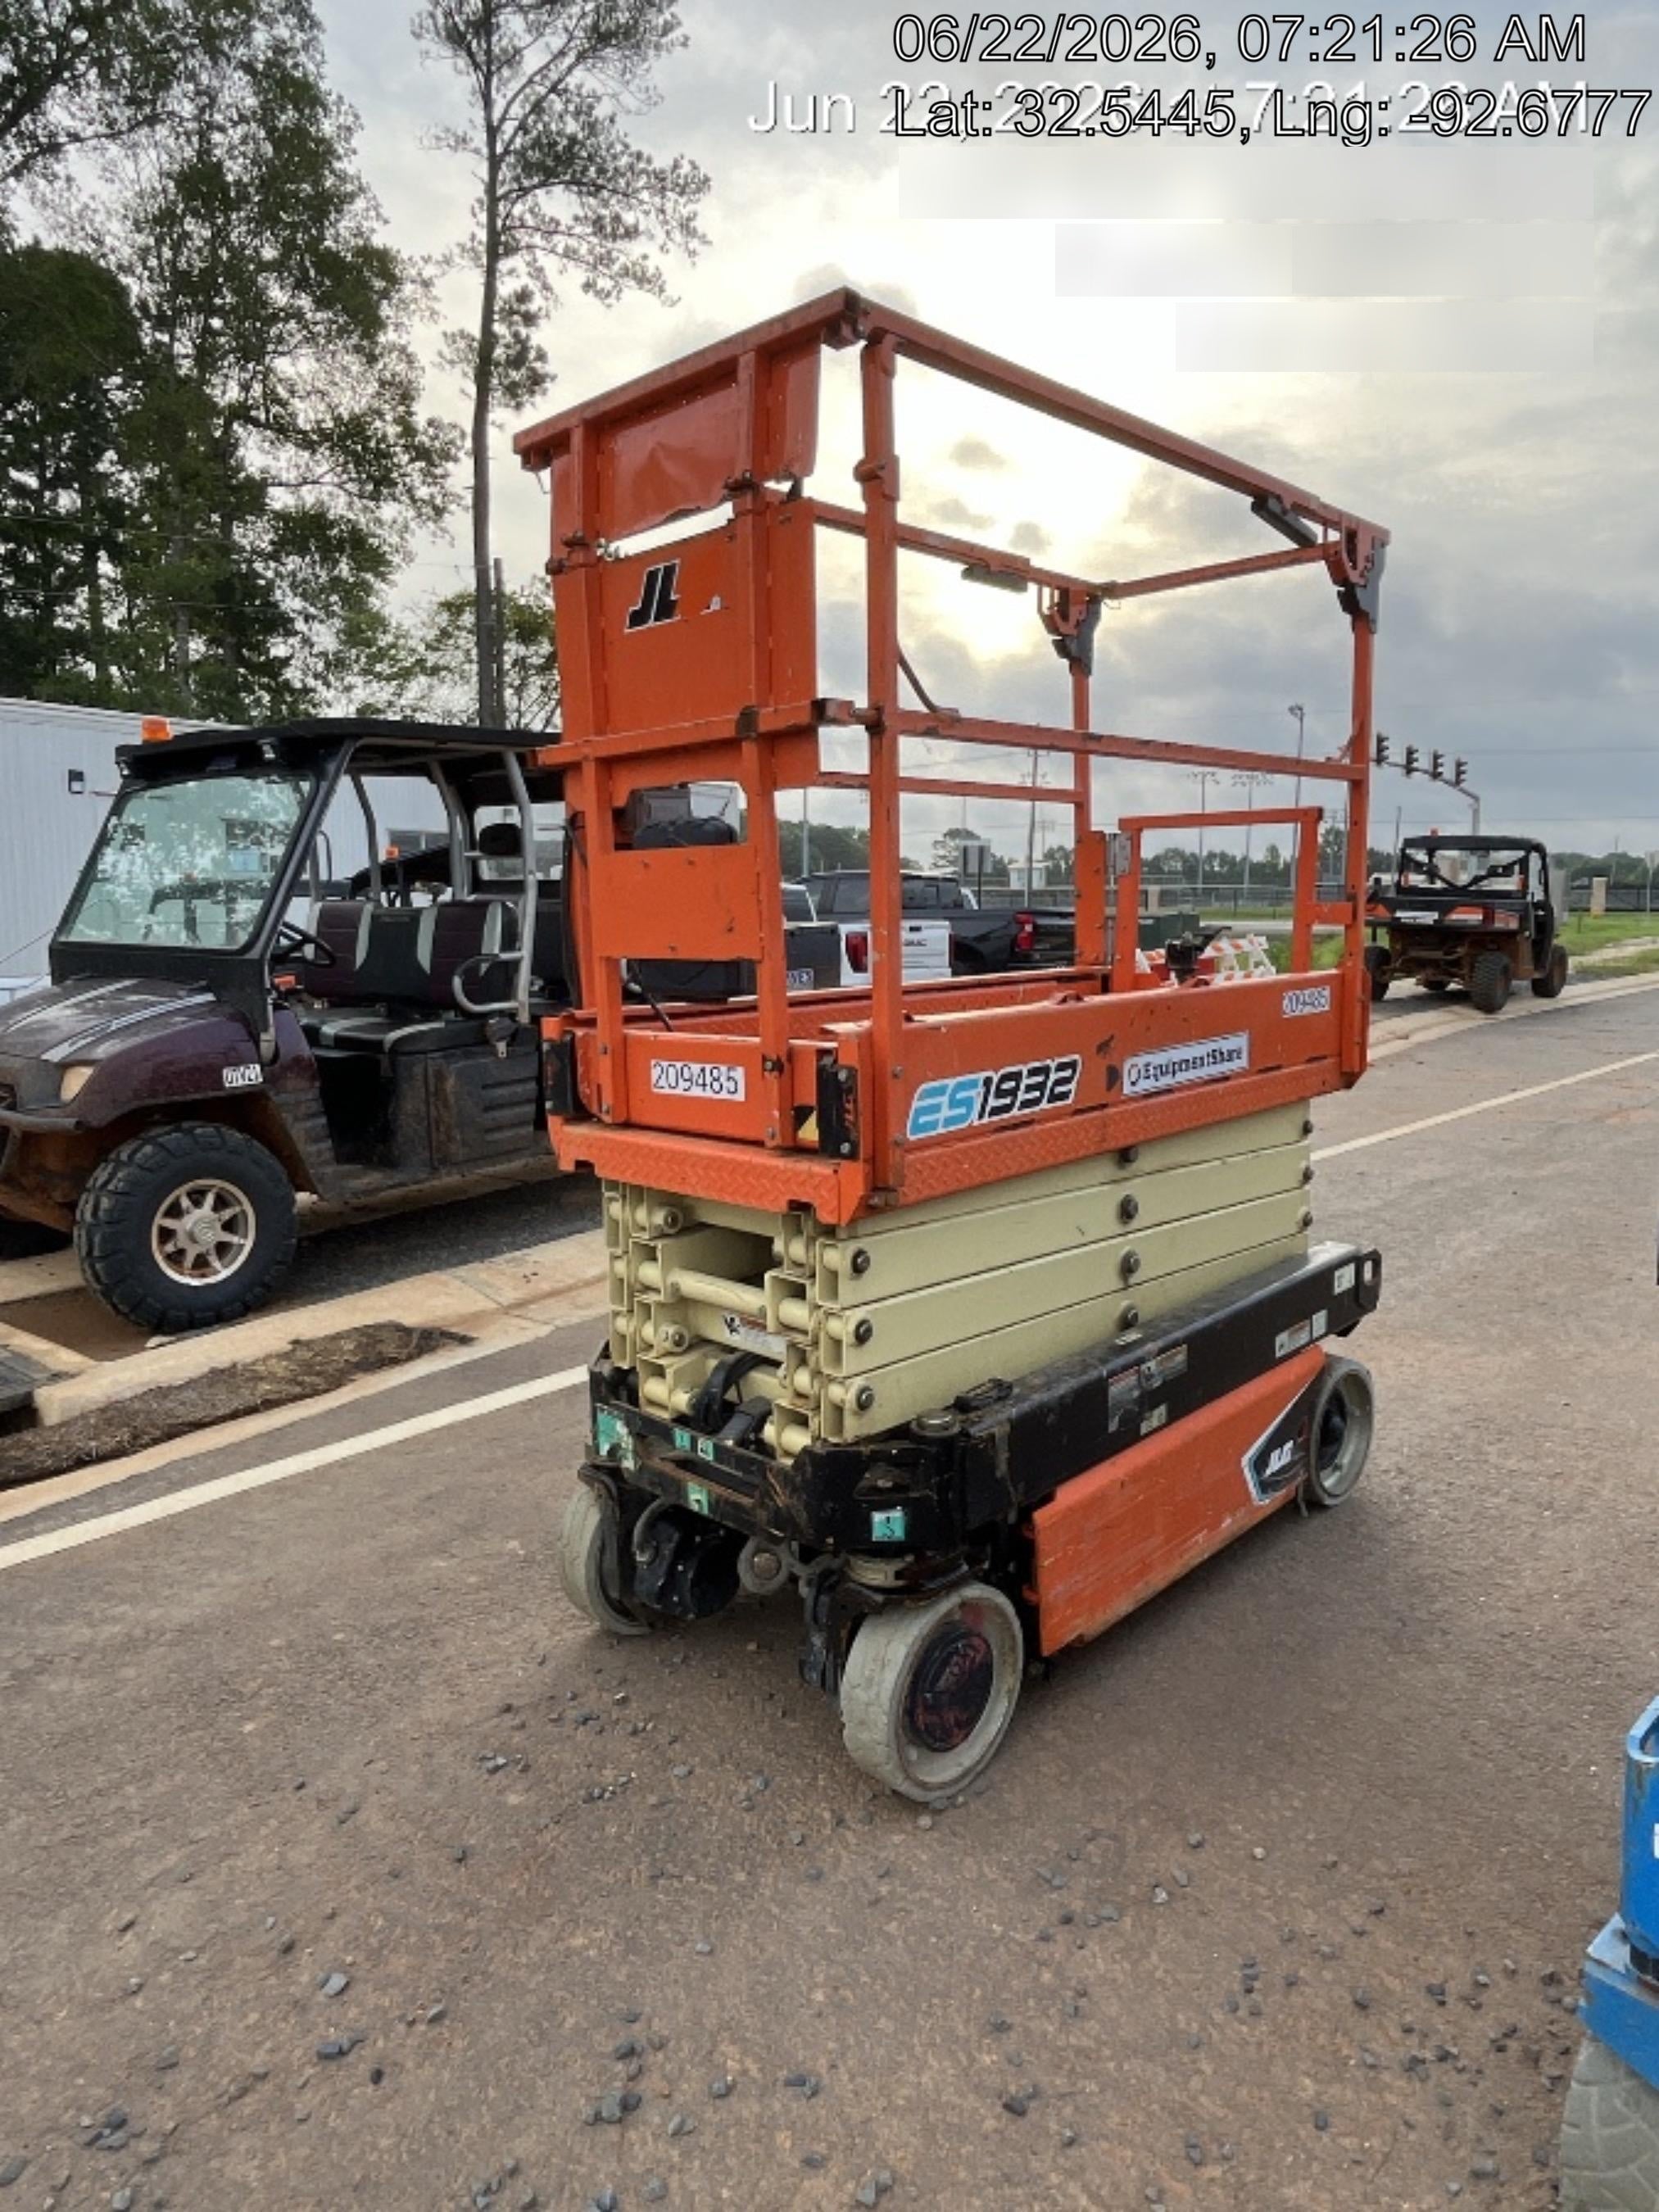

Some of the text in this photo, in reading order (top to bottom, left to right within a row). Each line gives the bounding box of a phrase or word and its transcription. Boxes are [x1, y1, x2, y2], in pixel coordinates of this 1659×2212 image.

[653, 1062, 738, 1095] 209485
[1143, 1046, 1244, 1082] EquipmentShare
[908, 1055, 1081, 1140] ES1932
